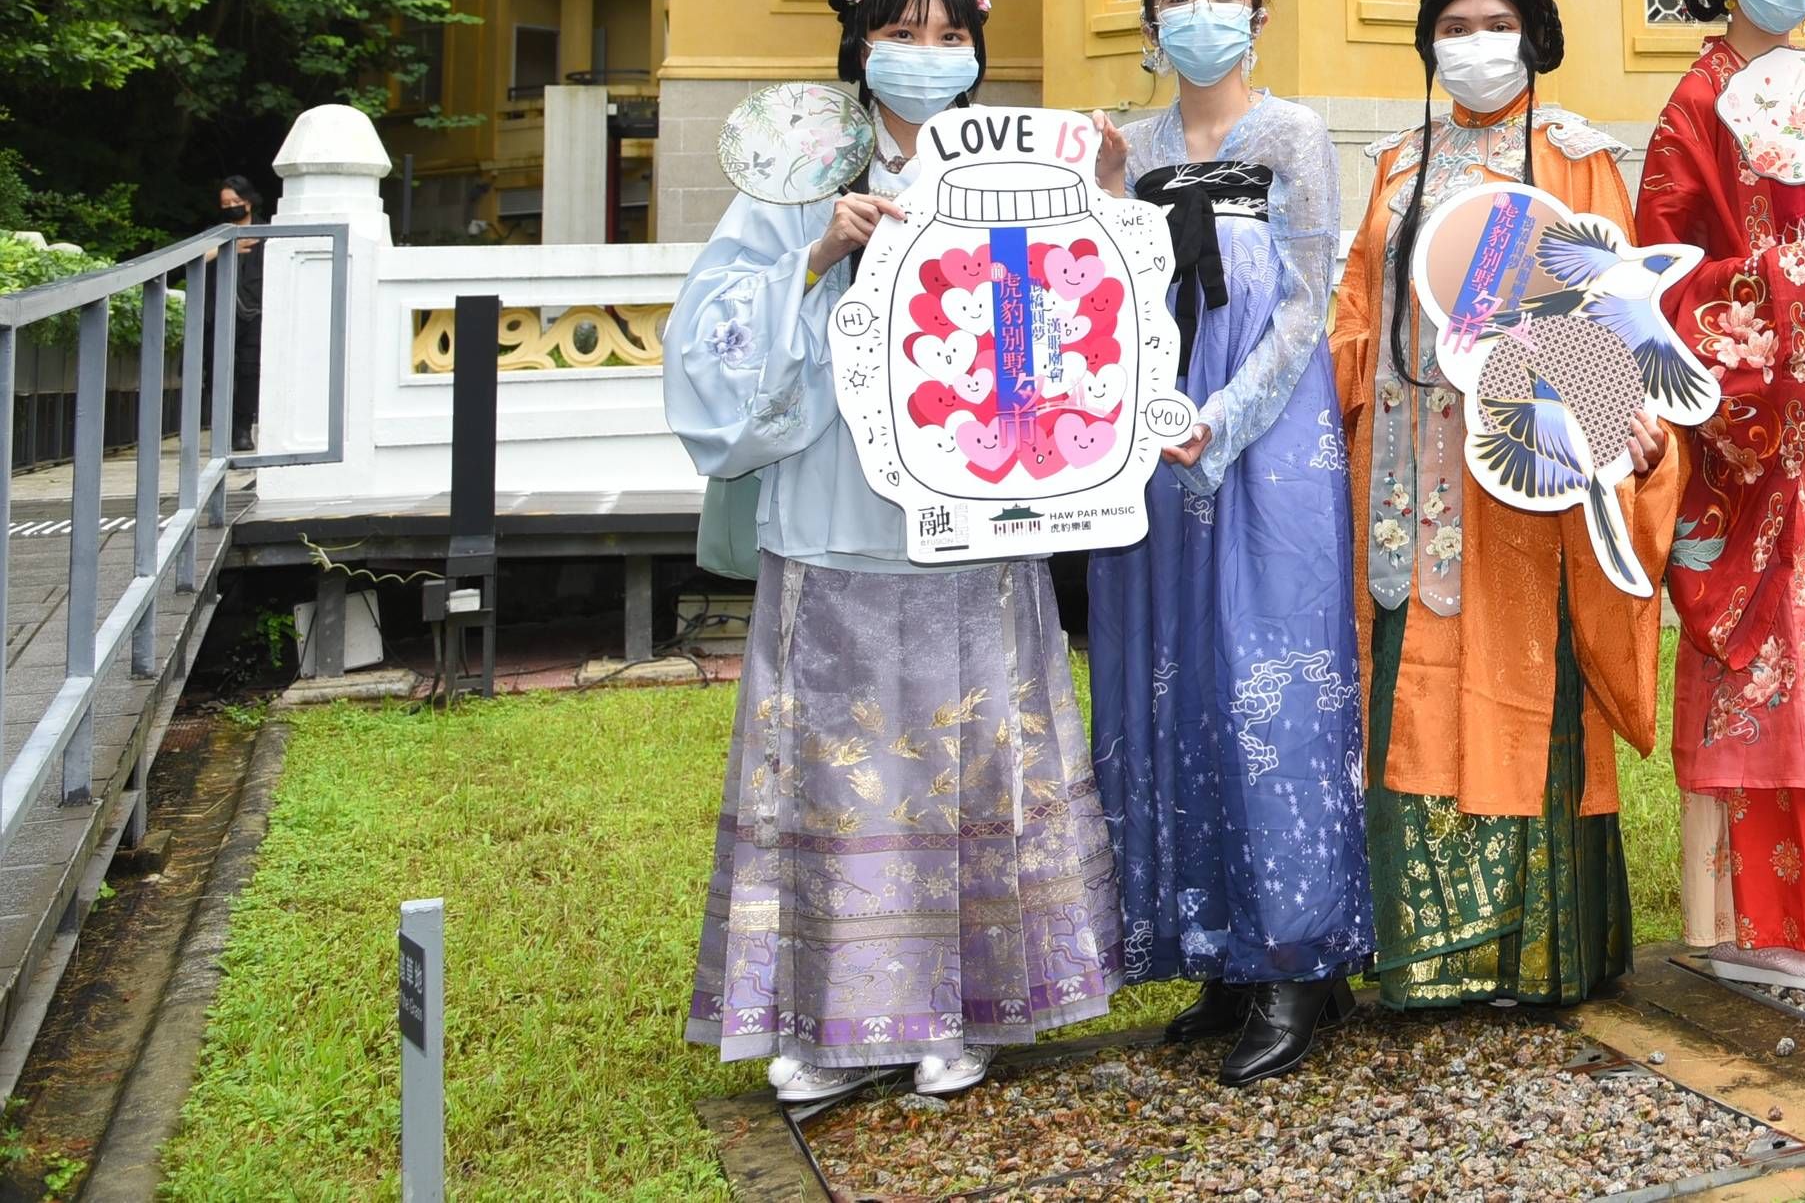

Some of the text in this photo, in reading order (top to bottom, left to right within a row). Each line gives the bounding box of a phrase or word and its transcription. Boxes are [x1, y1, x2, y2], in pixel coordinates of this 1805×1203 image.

[930, 115, 1088, 163] LOVE IS
[1121, 215, 1143, 227] WE
[1152, 408, 1186, 426] YOU
[918, 505, 953, 537] 融
[1050, 506, 1135, 521] HAW PAR MUSIC
